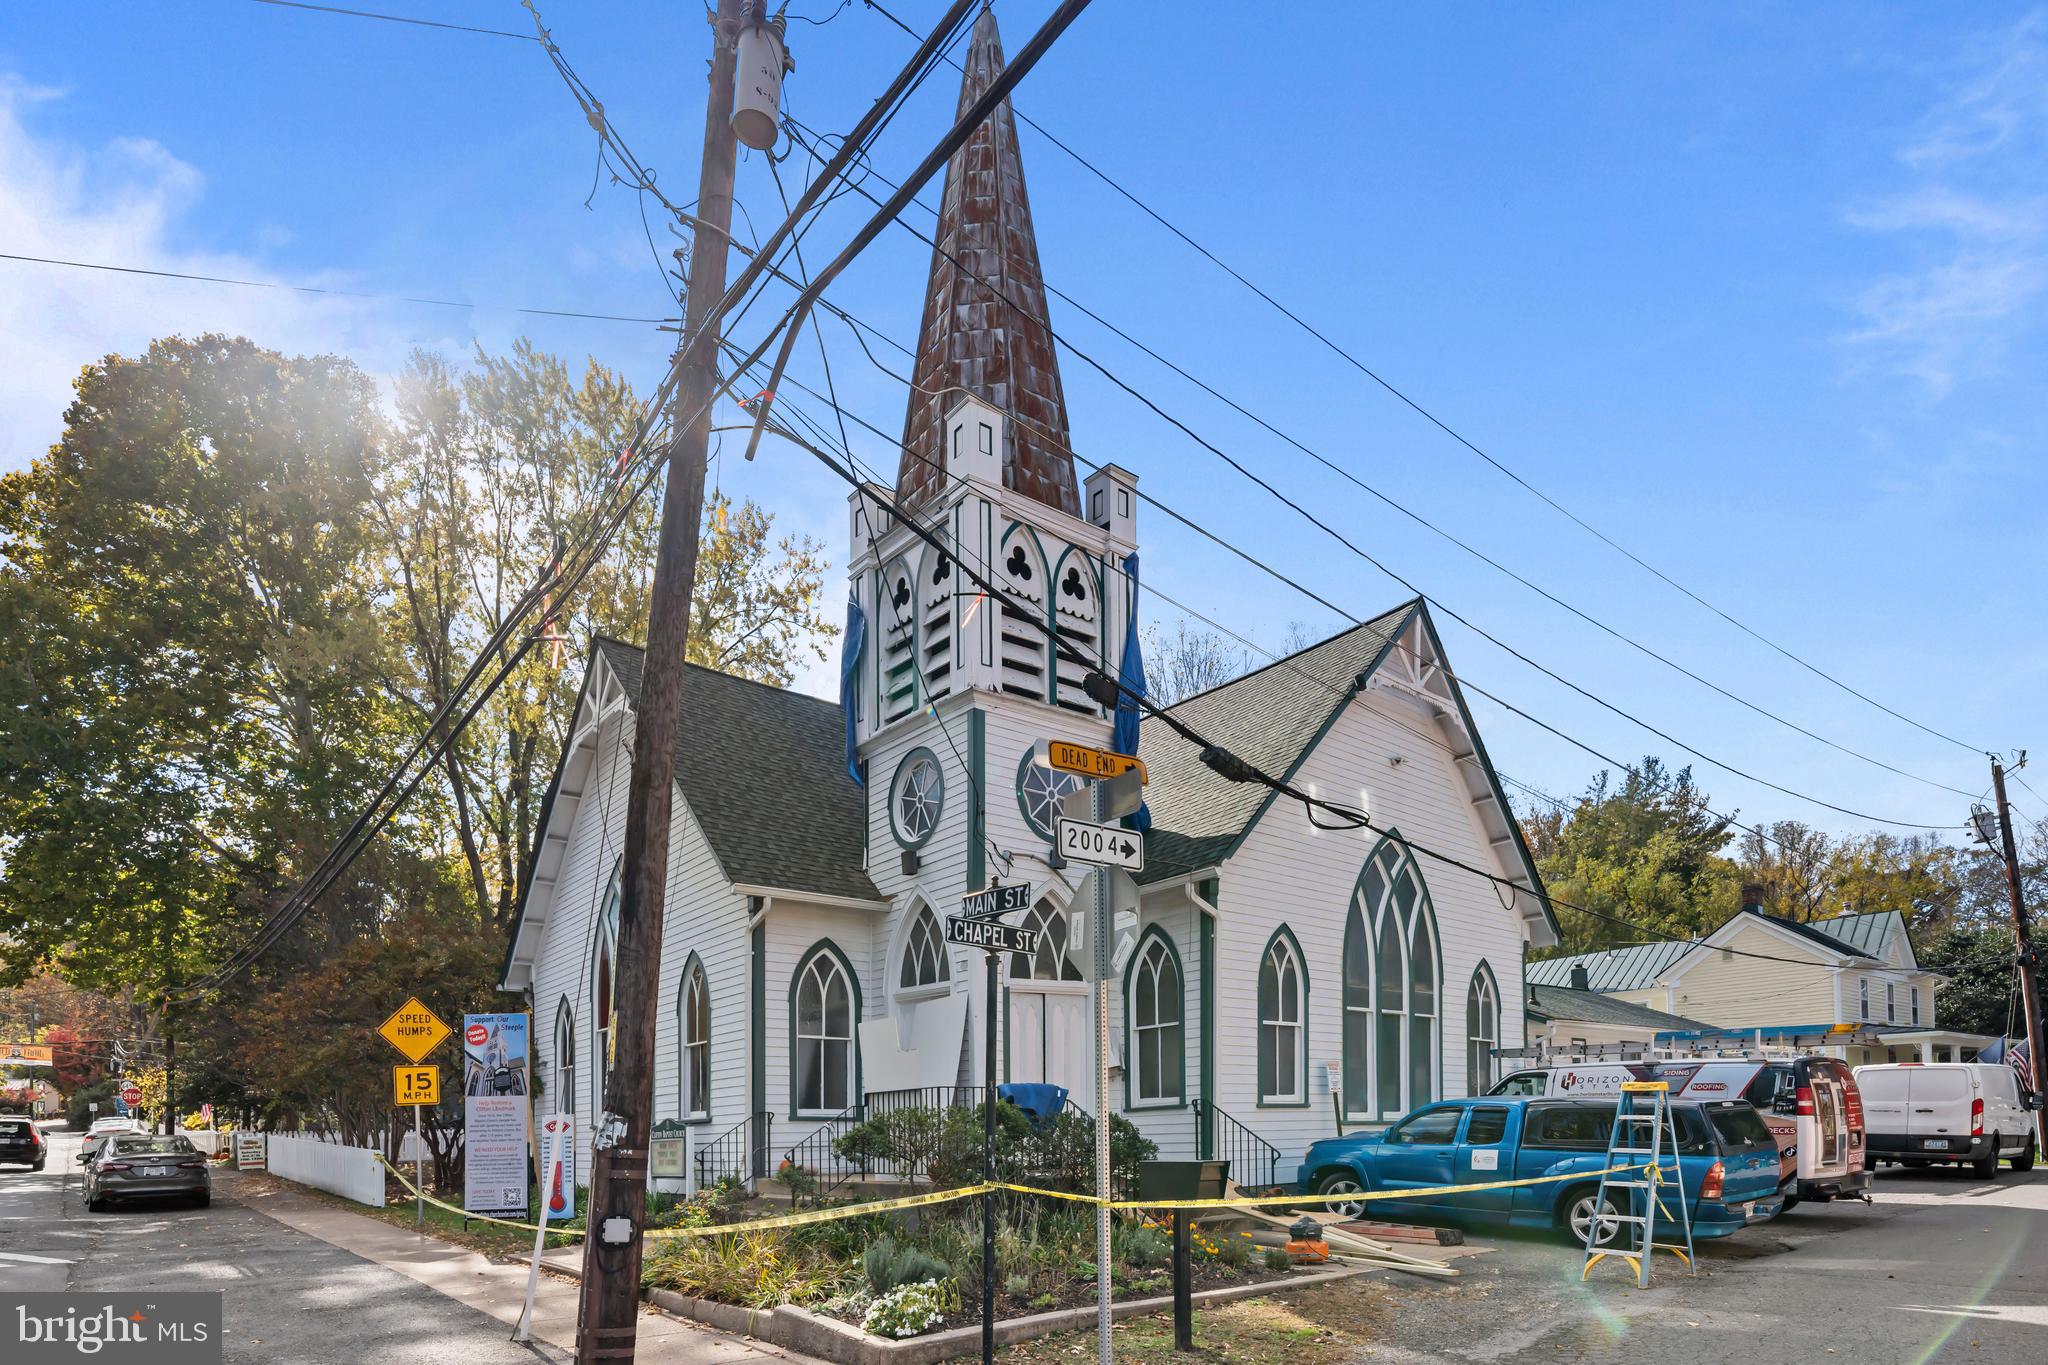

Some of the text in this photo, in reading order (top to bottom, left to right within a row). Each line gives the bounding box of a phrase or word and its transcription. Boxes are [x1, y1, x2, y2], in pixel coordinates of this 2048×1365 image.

[1062, 748, 1116, 773] DEAD END
[1068, 827, 1118, 855] 2004
[965, 887, 1024, 917] MAIN ST
[954, 921, 1031, 951] CHAPEL ST
[399, 1014, 431, 1024] SPEED
[470, 1016, 494, 1024] Support
[501, 1024, 524, 1032] Steeple
[397, 1027, 432, 1036] HUMPS
[405, 1072, 432, 1091] 15
